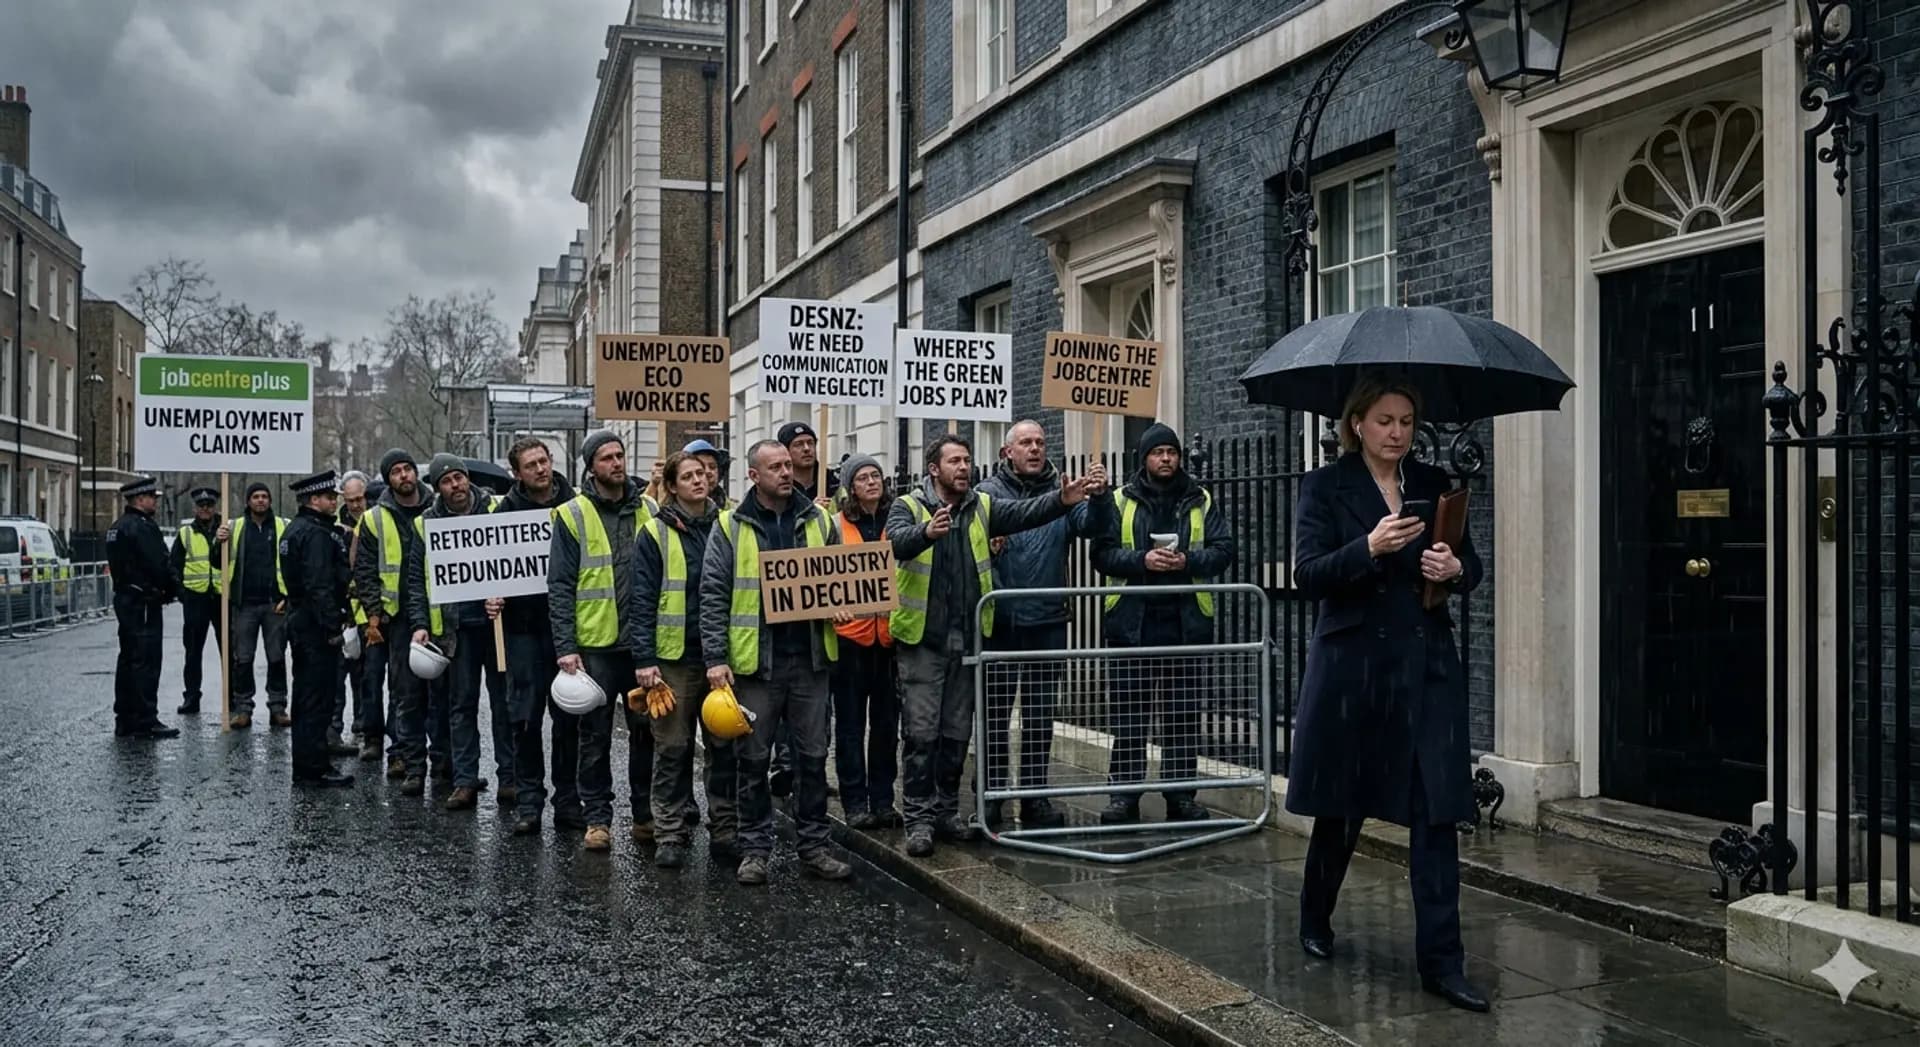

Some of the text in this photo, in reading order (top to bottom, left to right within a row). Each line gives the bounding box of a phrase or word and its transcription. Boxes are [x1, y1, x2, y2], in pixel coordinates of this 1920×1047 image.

[790, 305, 863, 330] DESNZ:
[1690, 303, 1714, 332] 11
[602, 341, 724, 363] UNEMPLOYED
[788, 332, 864, 353] WE NEED
[913, 337, 995, 360] WHERE'S
[1049, 338, 1157, 366] JOINING THE
[644, 366, 683, 387] ECO
[762, 354, 888, 375] COMMUNICATION
[904, 360, 1003, 385] THE GREEN
[1052, 361, 1152, 388] JOBCENTRE
[160, 367, 291, 393] jobcentreplus
[765, 375, 884, 398] NOT NEGLECT!
[615, 390, 711, 413] WORKERS
[899, 385, 1008, 409] JOBS PLAN?
[144, 407, 304, 432] UNEMPLOYMENT
[189, 433, 261, 455] CLAIMS
[429, 521, 552, 552] RETROFITTERS
[434, 554, 549, 587] REDUNDANT
[764, 550, 890, 581] ECO INDUSTRY
[771, 577, 891, 613] IN DECLINE
